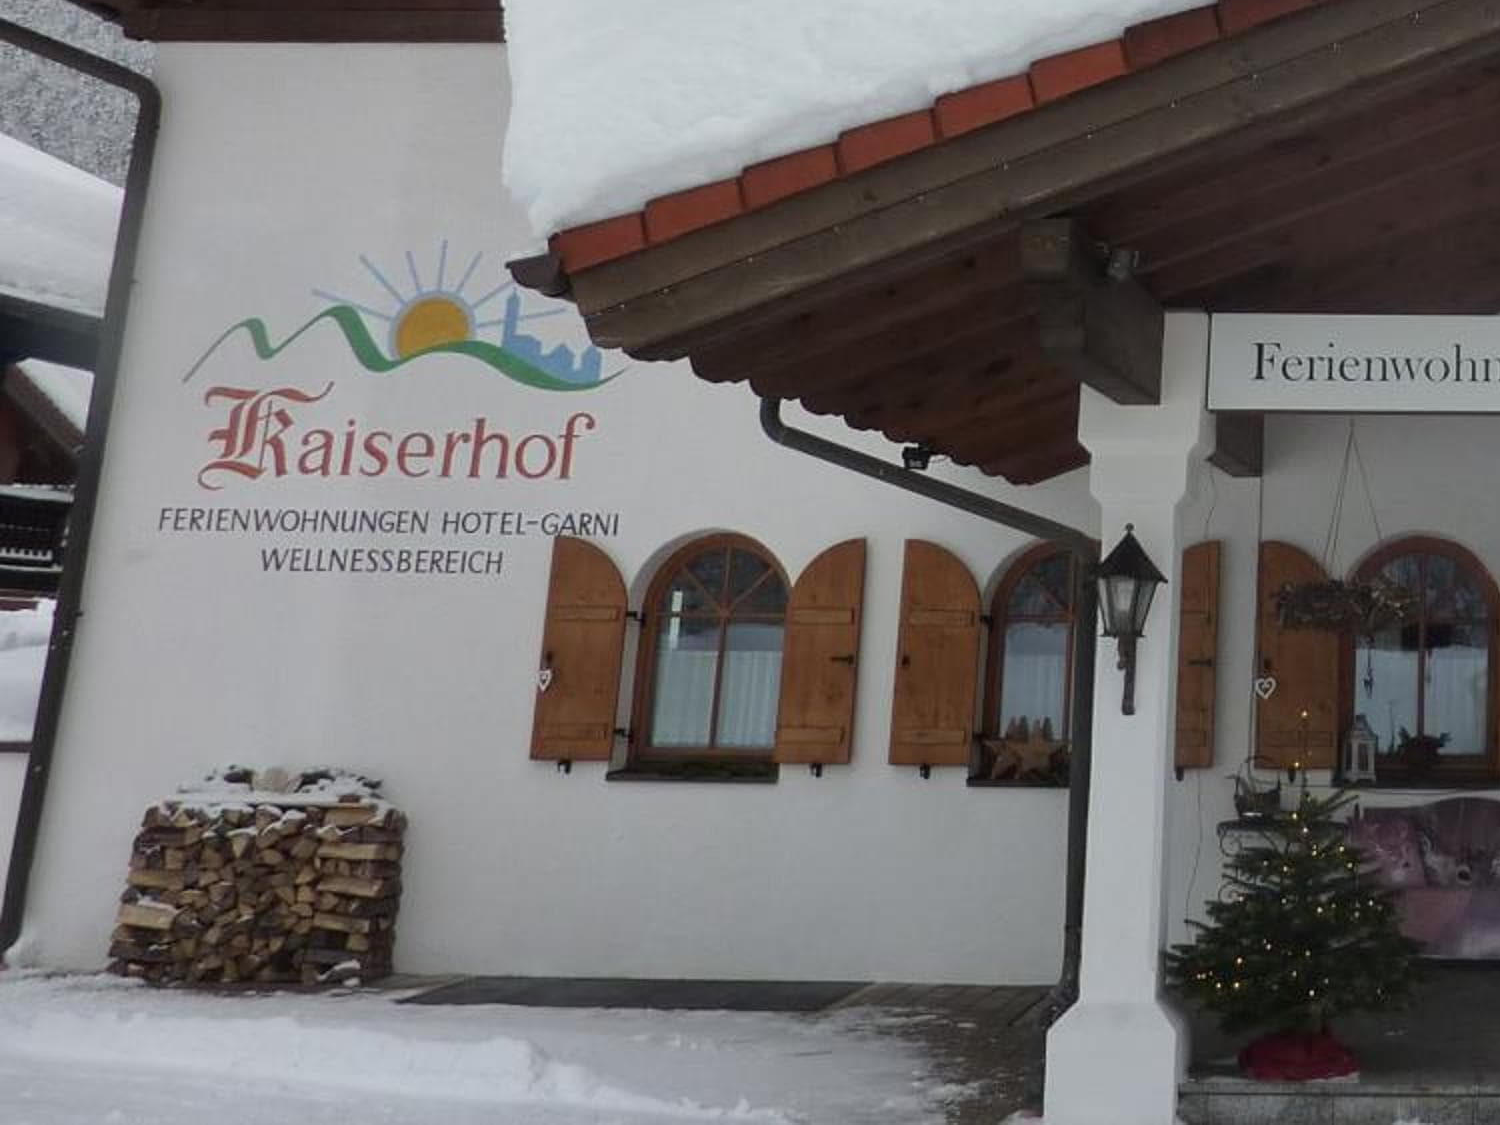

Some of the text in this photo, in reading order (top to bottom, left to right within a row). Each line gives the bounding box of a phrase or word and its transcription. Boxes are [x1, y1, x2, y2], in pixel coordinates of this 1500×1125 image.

[197, 381, 596, 490] Kaiserhof
[158, 507, 620, 537] FERIENWOHNUNGEN HOTEL-GARNI
[261, 549, 503, 574] WELLNESSBEREICH
